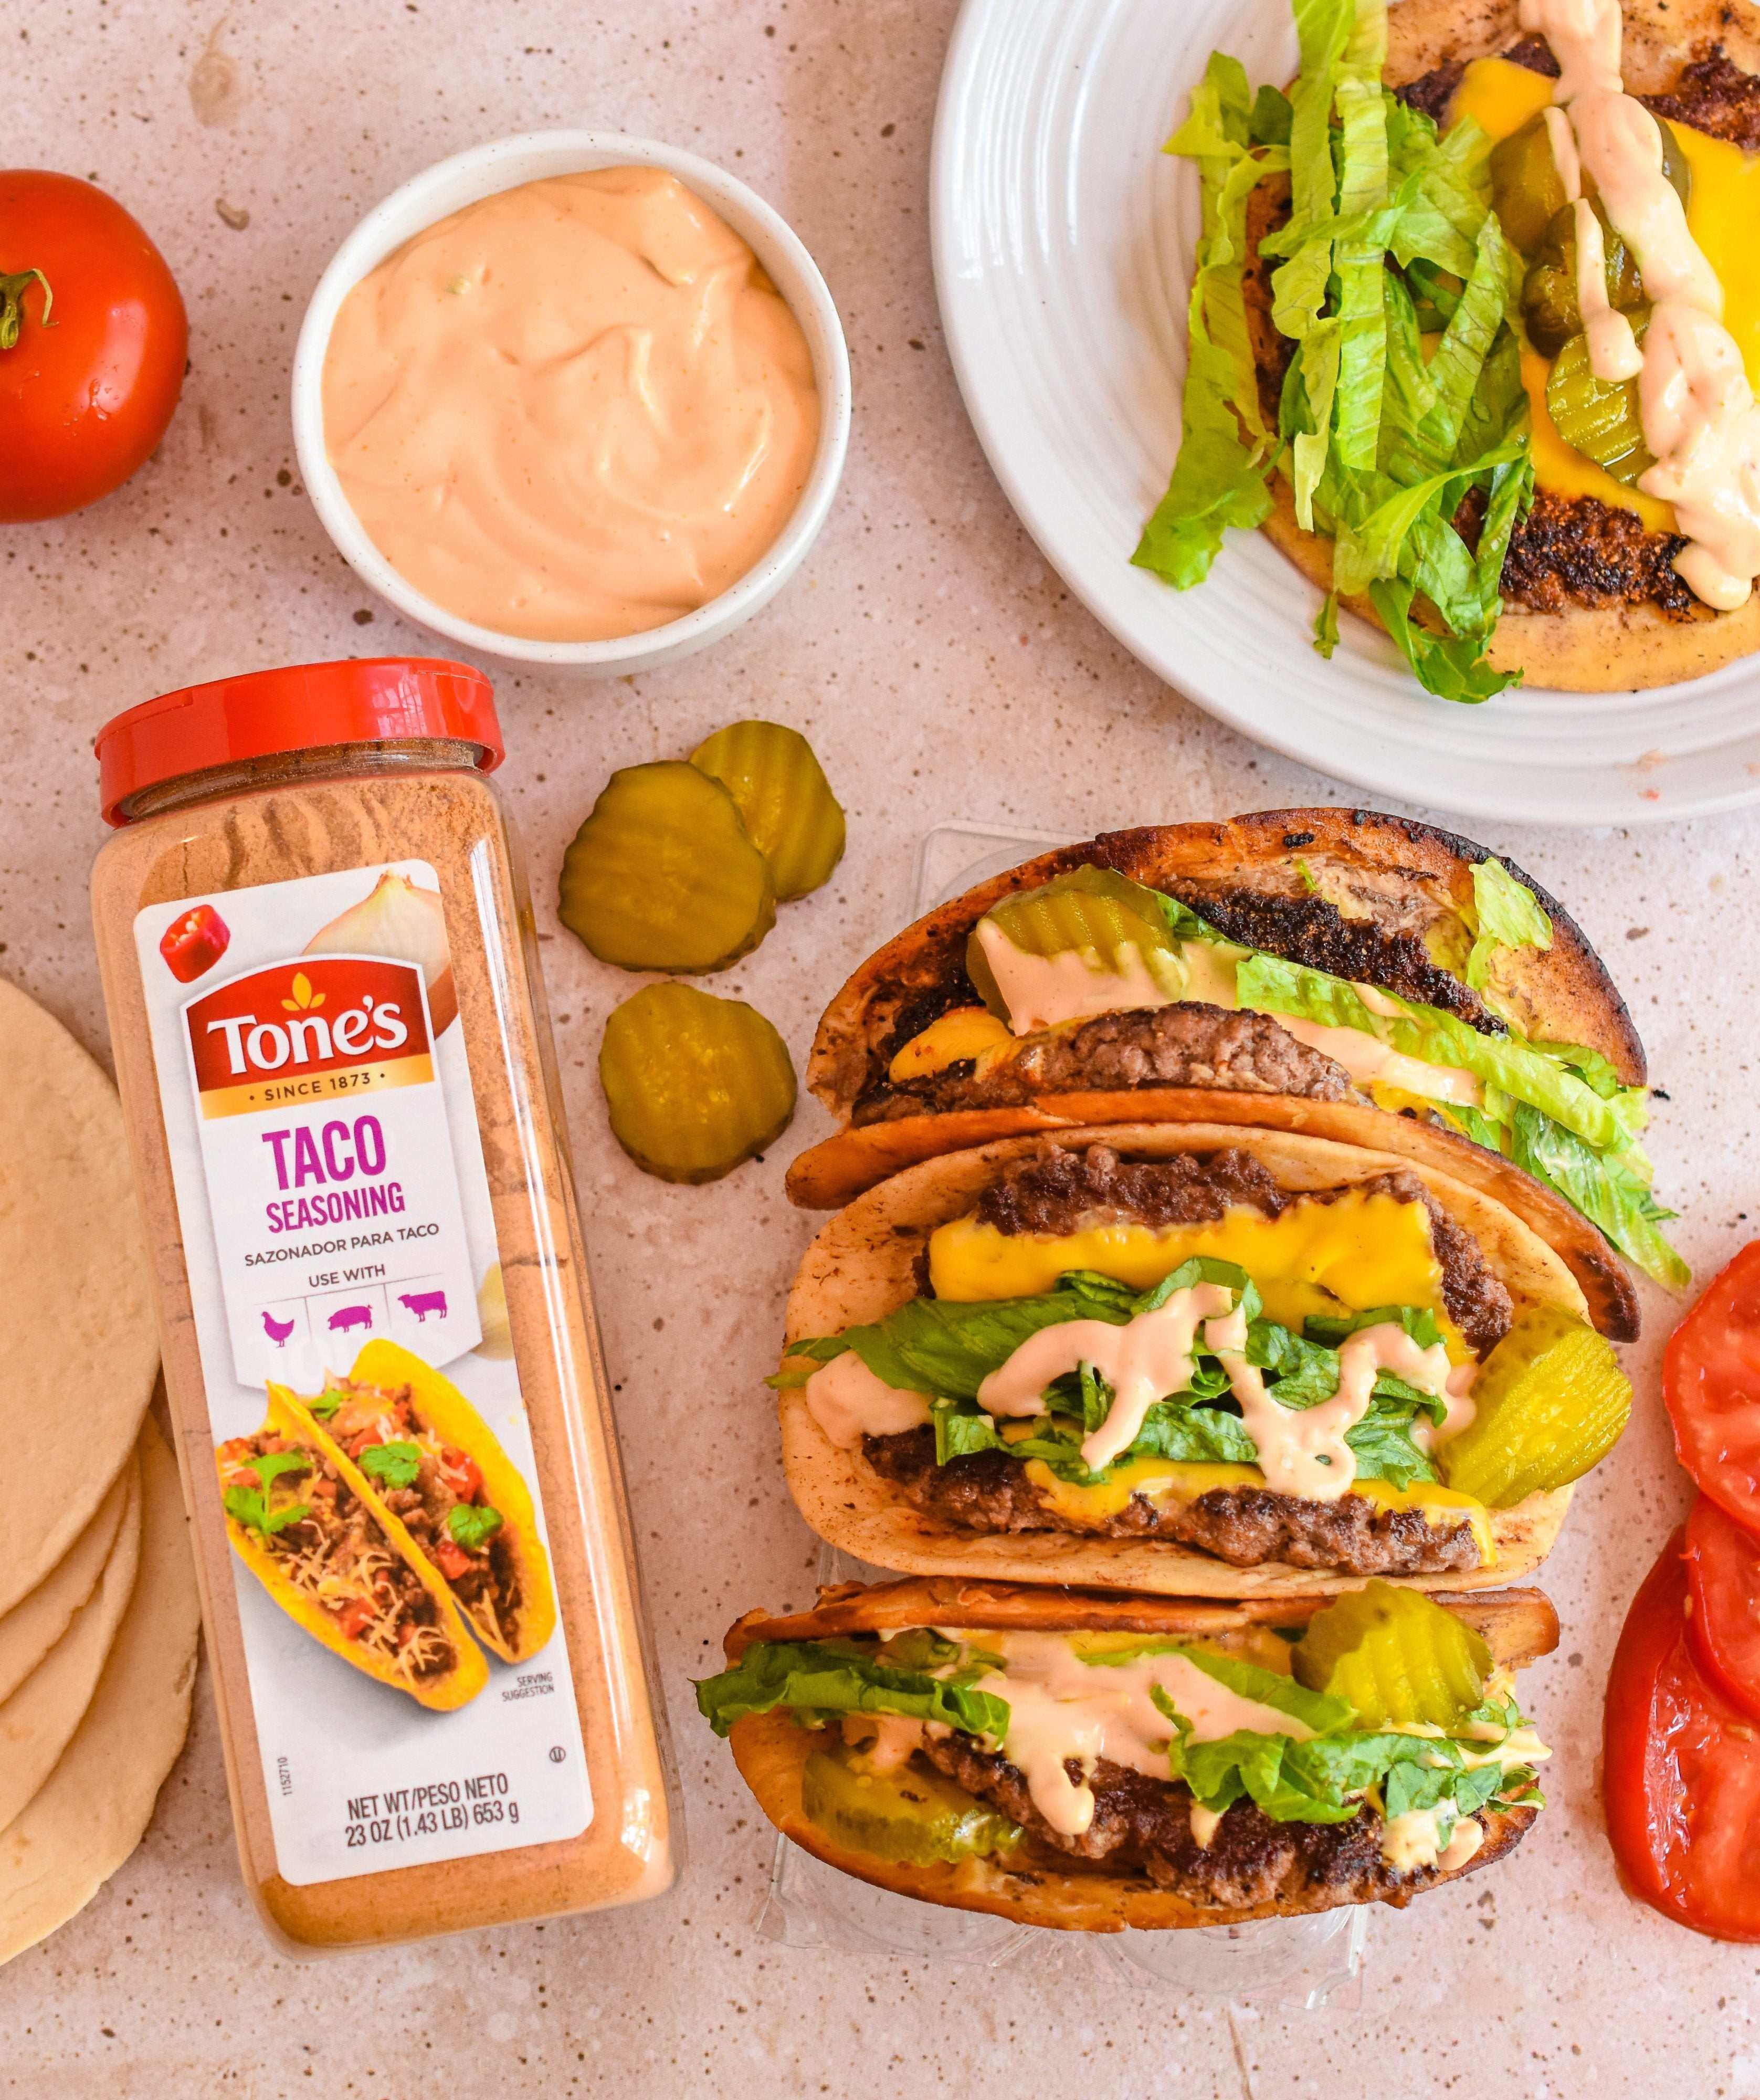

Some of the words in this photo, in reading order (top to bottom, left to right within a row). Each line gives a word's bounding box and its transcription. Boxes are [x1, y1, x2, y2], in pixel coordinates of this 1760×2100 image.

[207, 995, 408, 1075] Tone's
[265, 1080, 322, 1101] SINCE
[330, 1073, 371, 1090] 1873
[262, 1115, 387, 1190] TACO
[266, 1182, 405, 1233] SEASONING
[245, 1239, 346, 1267] SAZONADOR
[351, 1233, 393, 1248] PARA
[397, 1223, 439, 1241] TACO
[309, 1272, 340, 1288] USE
[343, 1264, 386, 1282] WITH
[502, 1684, 554, 1702] SUGGESTION
[517, 1672, 553, 1687] SERVING
[277, 1757, 292, 1796] 1152710
[347, 1795, 378, 1821] NET
[384, 1781, 460, 1814] WT/PESO
[465, 1772, 509, 1800] NETO
[345, 1824, 366, 1847] 23
[371, 1819, 393, 1843] OZ
[397, 1811, 438, 1841] (1.43
[441, 1804, 469, 1830] LB)
[473, 1800, 504, 1824] 653
[509, 1802, 520, 1824] g
